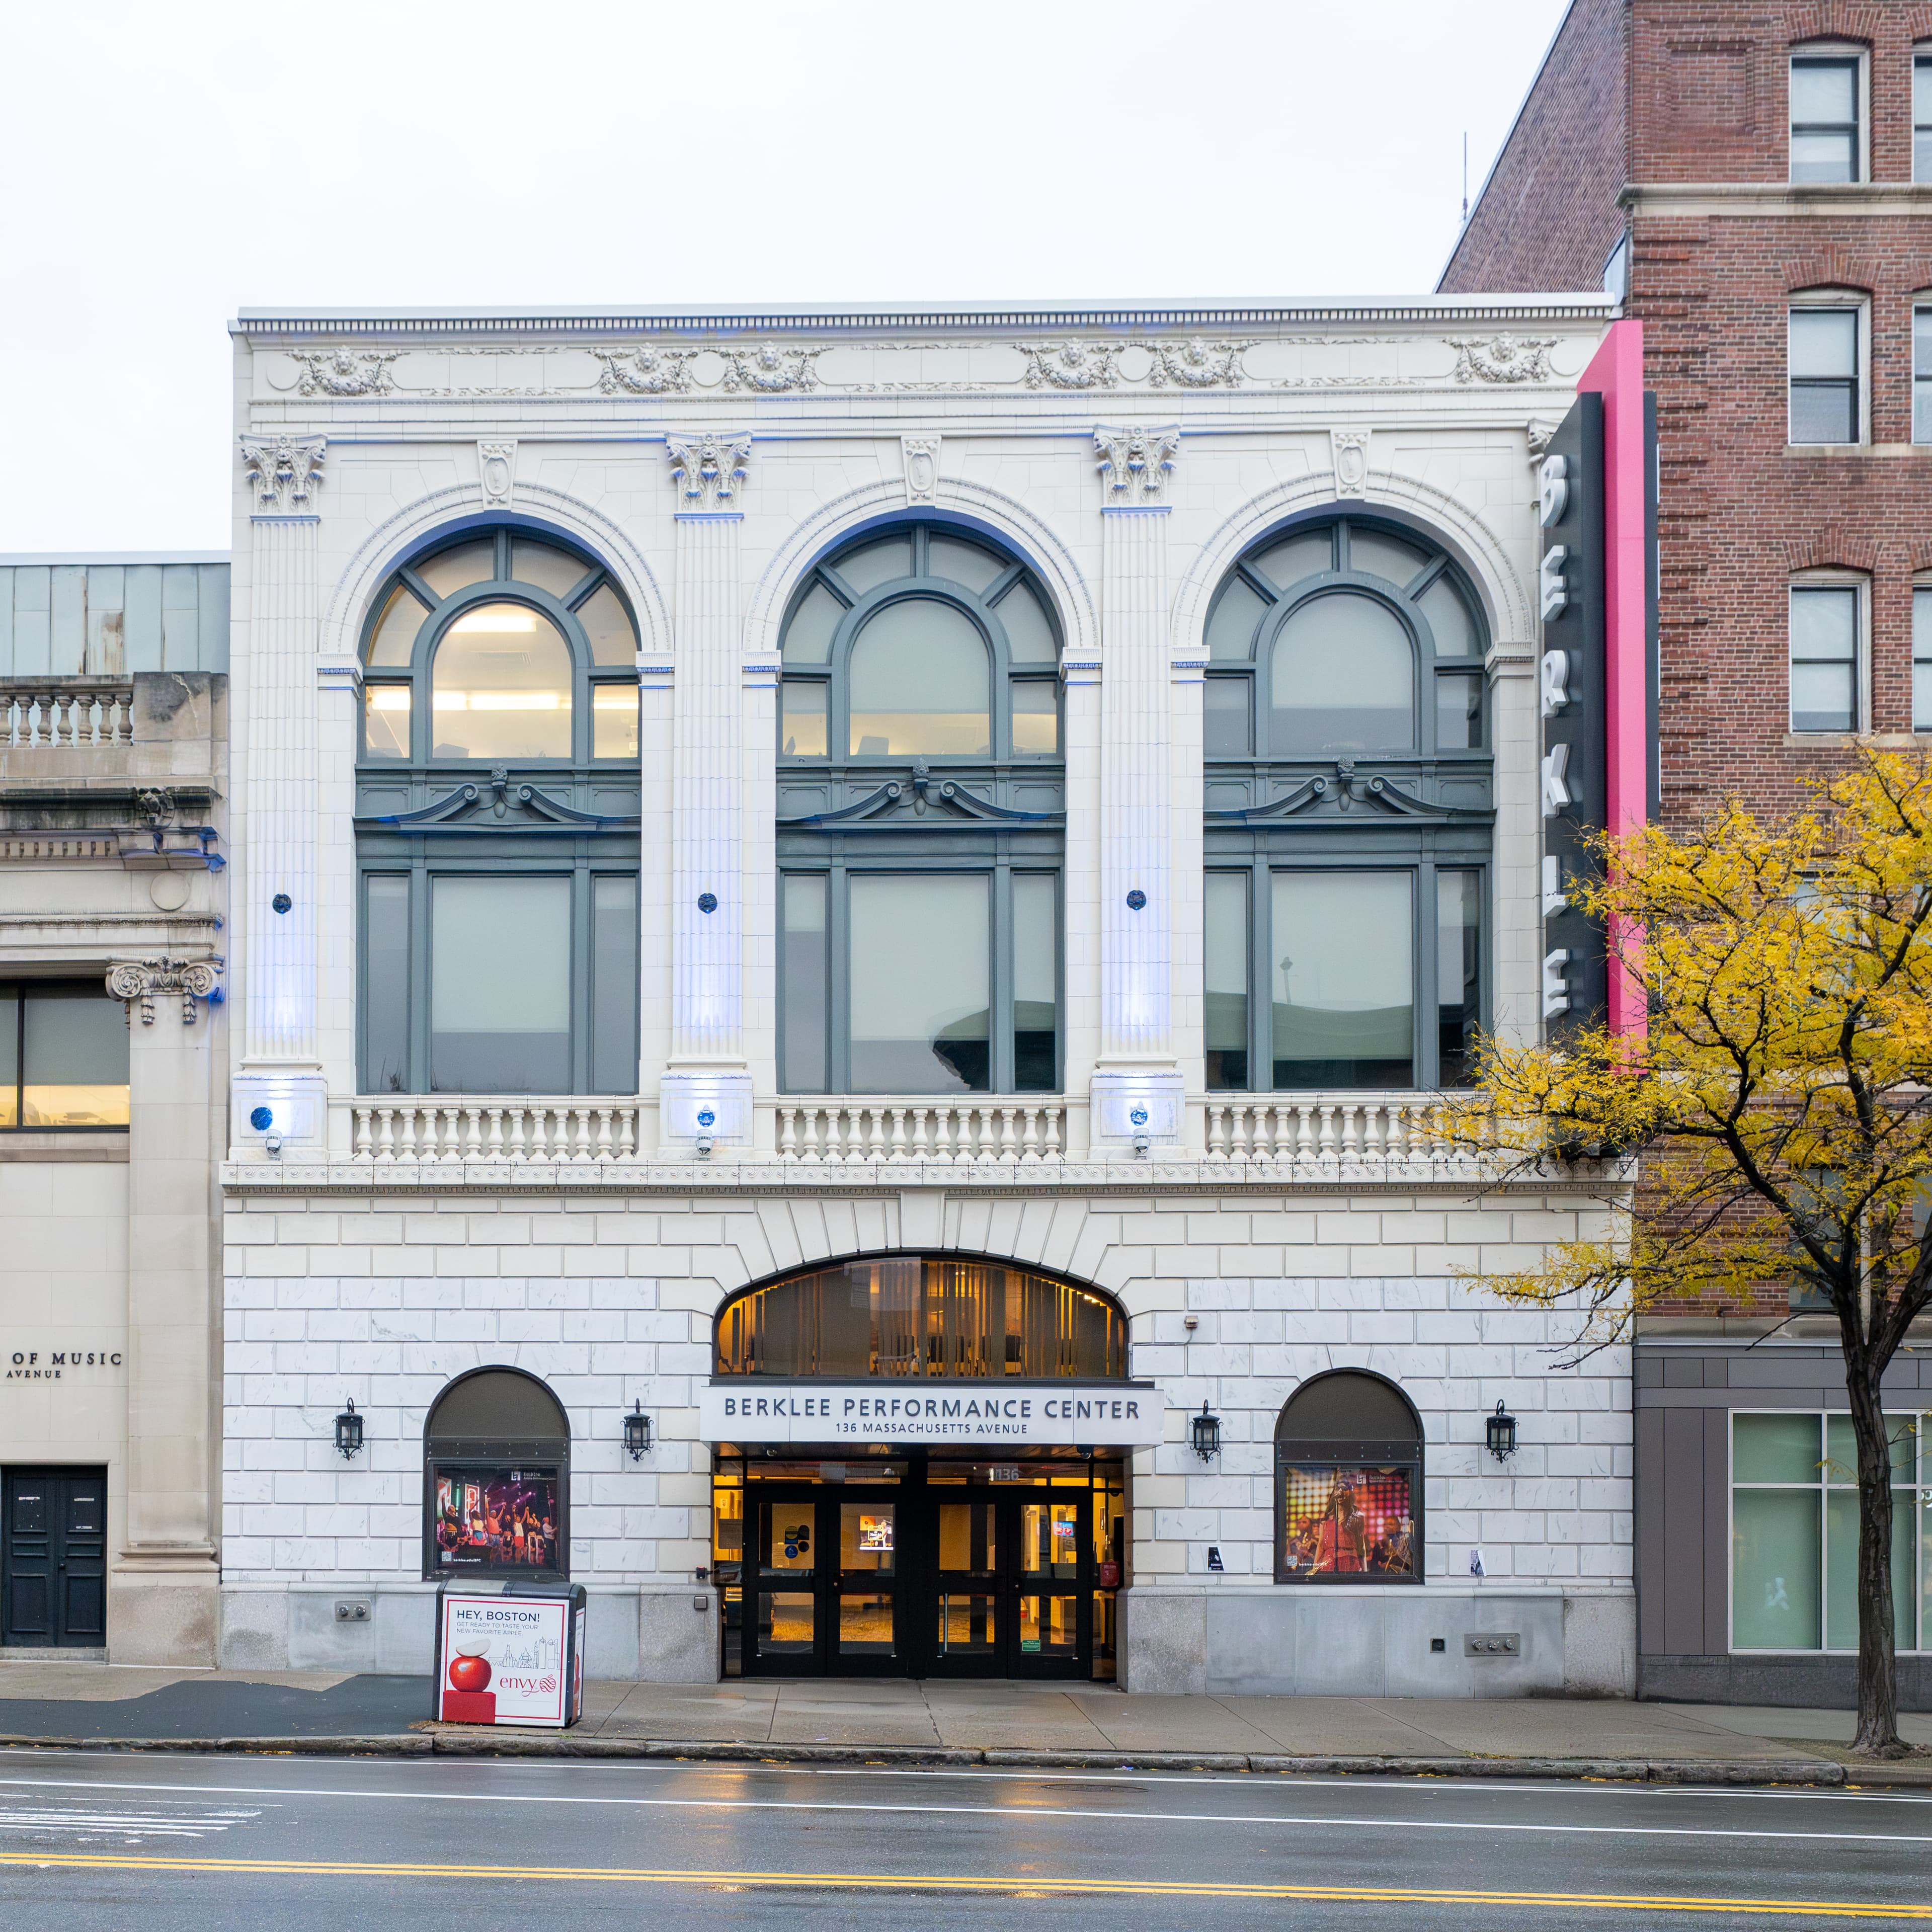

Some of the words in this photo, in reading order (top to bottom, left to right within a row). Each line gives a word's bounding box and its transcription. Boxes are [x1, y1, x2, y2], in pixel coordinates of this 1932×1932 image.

[1540, 454, 1571, 1106] BERKLE
[12, 1352, 38, 1364] OF
[52, 1353, 121, 1365] MUSIC
[7, 1370, 61, 1378] AVENUE
[725, 1398, 830, 1416] BERKLEE
[844, 1399, 1031, 1418] PERFORMANCE
[1044, 1400, 1139, 1419] CENTER
[836, 1423, 857, 1432] 136
[863, 1423, 971, 1433] MASSACHUSETTS
[976, 1424, 1027, 1433] AVENUE
[457, 1610, 482, 1621] HEY,
[487, 1611, 540, 1622] BOSTON!
[500, 1677, 540, 1697] envy
